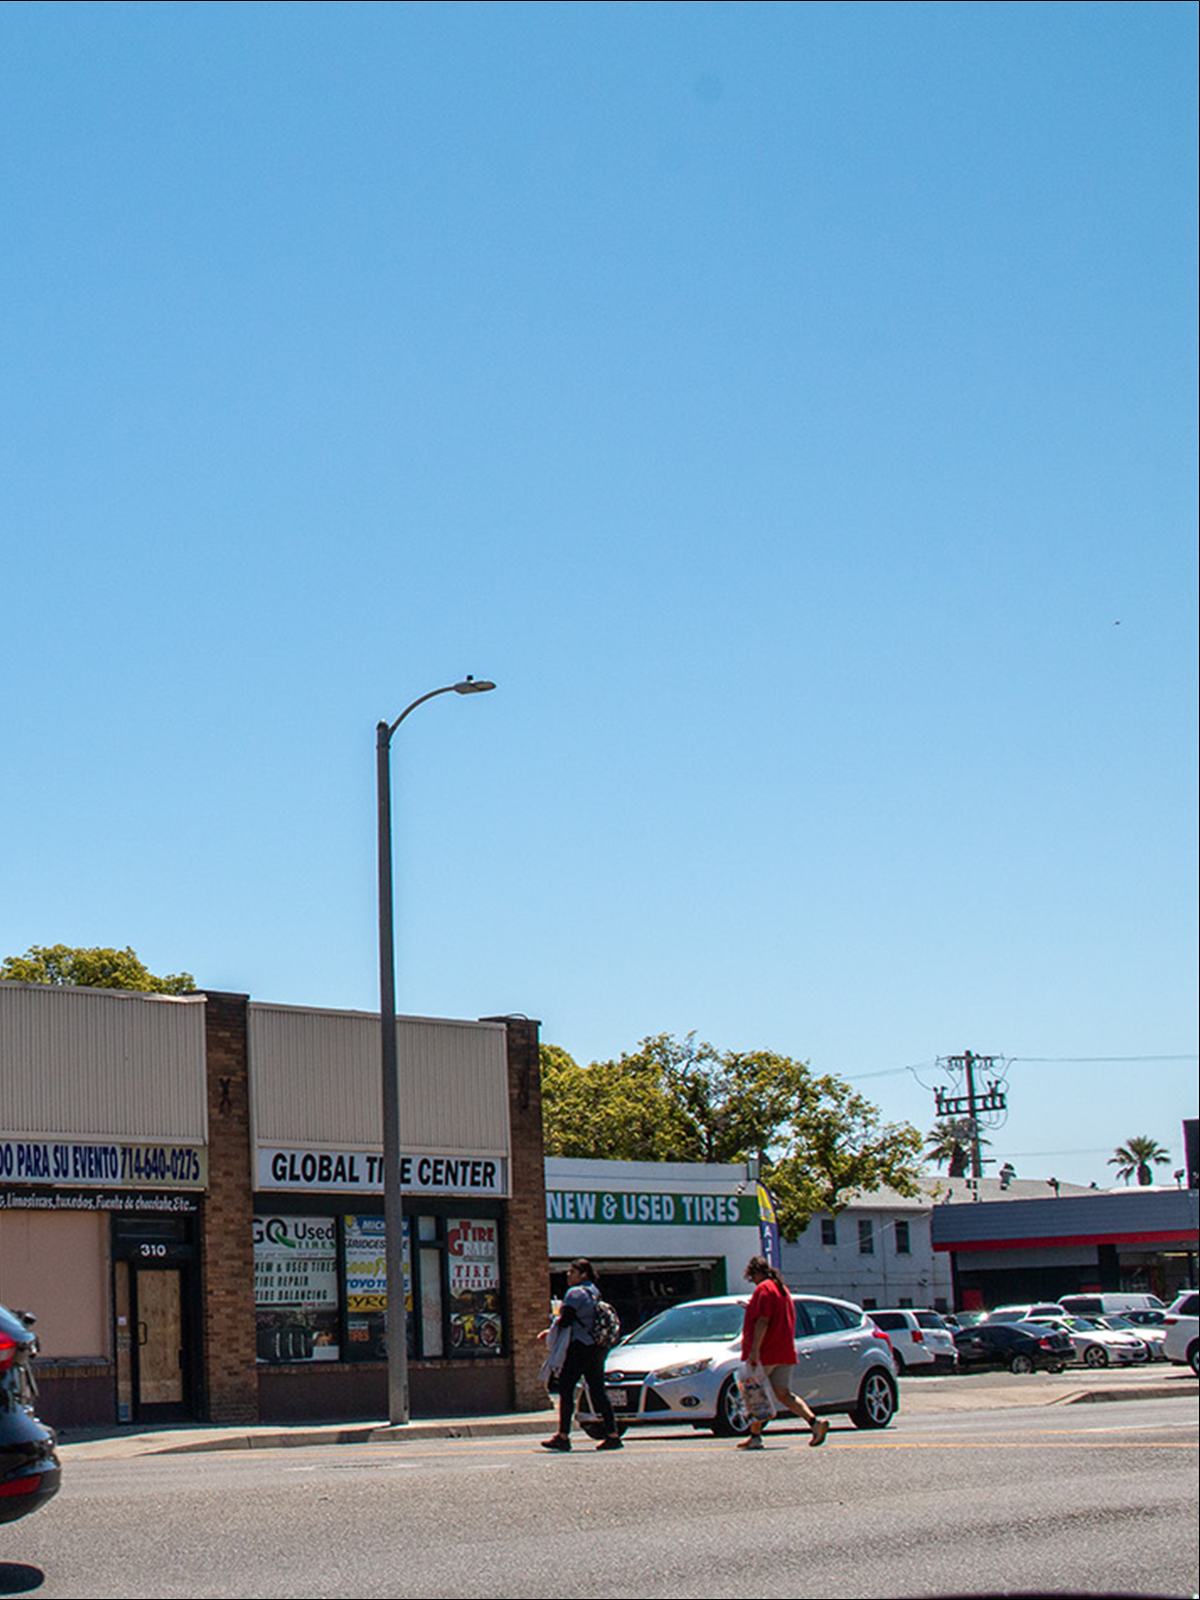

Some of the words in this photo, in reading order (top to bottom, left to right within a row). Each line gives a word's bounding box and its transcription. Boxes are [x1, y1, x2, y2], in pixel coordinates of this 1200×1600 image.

[17, 1143, 51, 1178] PARA
[53, 1144, 69, 1179] SU
[72, 1145, 118, 1180] EVENTO
[120, 1147, 200, 1181] 714-640-0275
[272, 1152, 360, 1183] GLOBAL
[366, 1156, 412, 1185] TIE
[418, 1158, 496, 1188] CENTER
[546, 1192, 597, 1221] NEW
[602, 1193, 617, 1220] &
[623, 1194, 676, 1222] USED
[682, 1196, 740, 1223] TIRES
[294, 1222, 335, 1240] Used
[459, 1221, 495, 1242] TIRE
[141, 1243, 167, 1257] 310
[277, 1275, 309, 1287] REPAIR
[456, 1265, 491, 1278] TIRE
